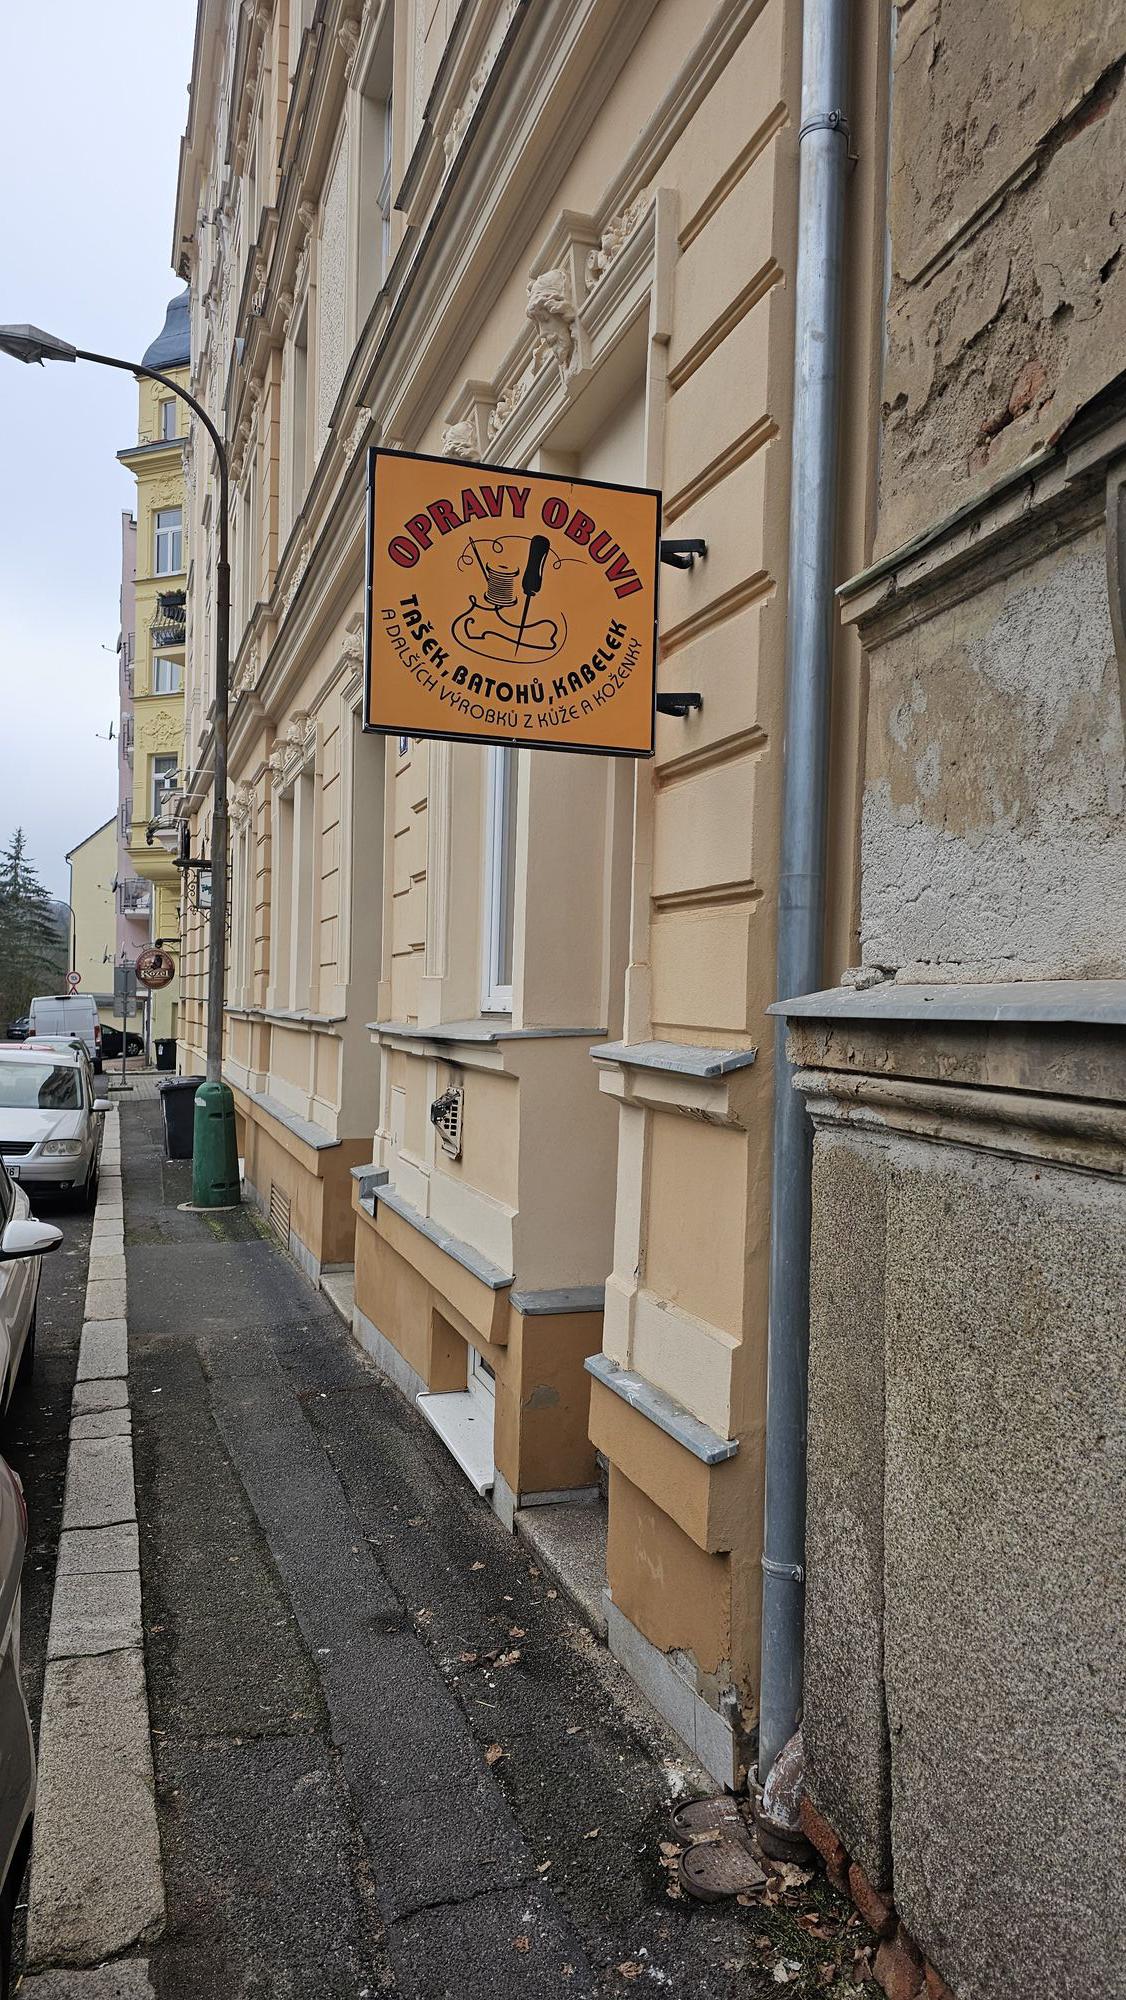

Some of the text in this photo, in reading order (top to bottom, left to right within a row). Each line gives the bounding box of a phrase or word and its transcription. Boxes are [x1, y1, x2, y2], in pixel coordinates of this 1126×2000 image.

[388, 485, 643, 599] OPRAVY OBUVI
[381, 609, 642, 728] A DALŠÍCH VÝROBKŮ Z KŮŽE A KOŽENKY
[400, 594, 627, 705] TAŠEK, BATOHŮ, KABELEK
[141, 970, 169, 978] Kozel
